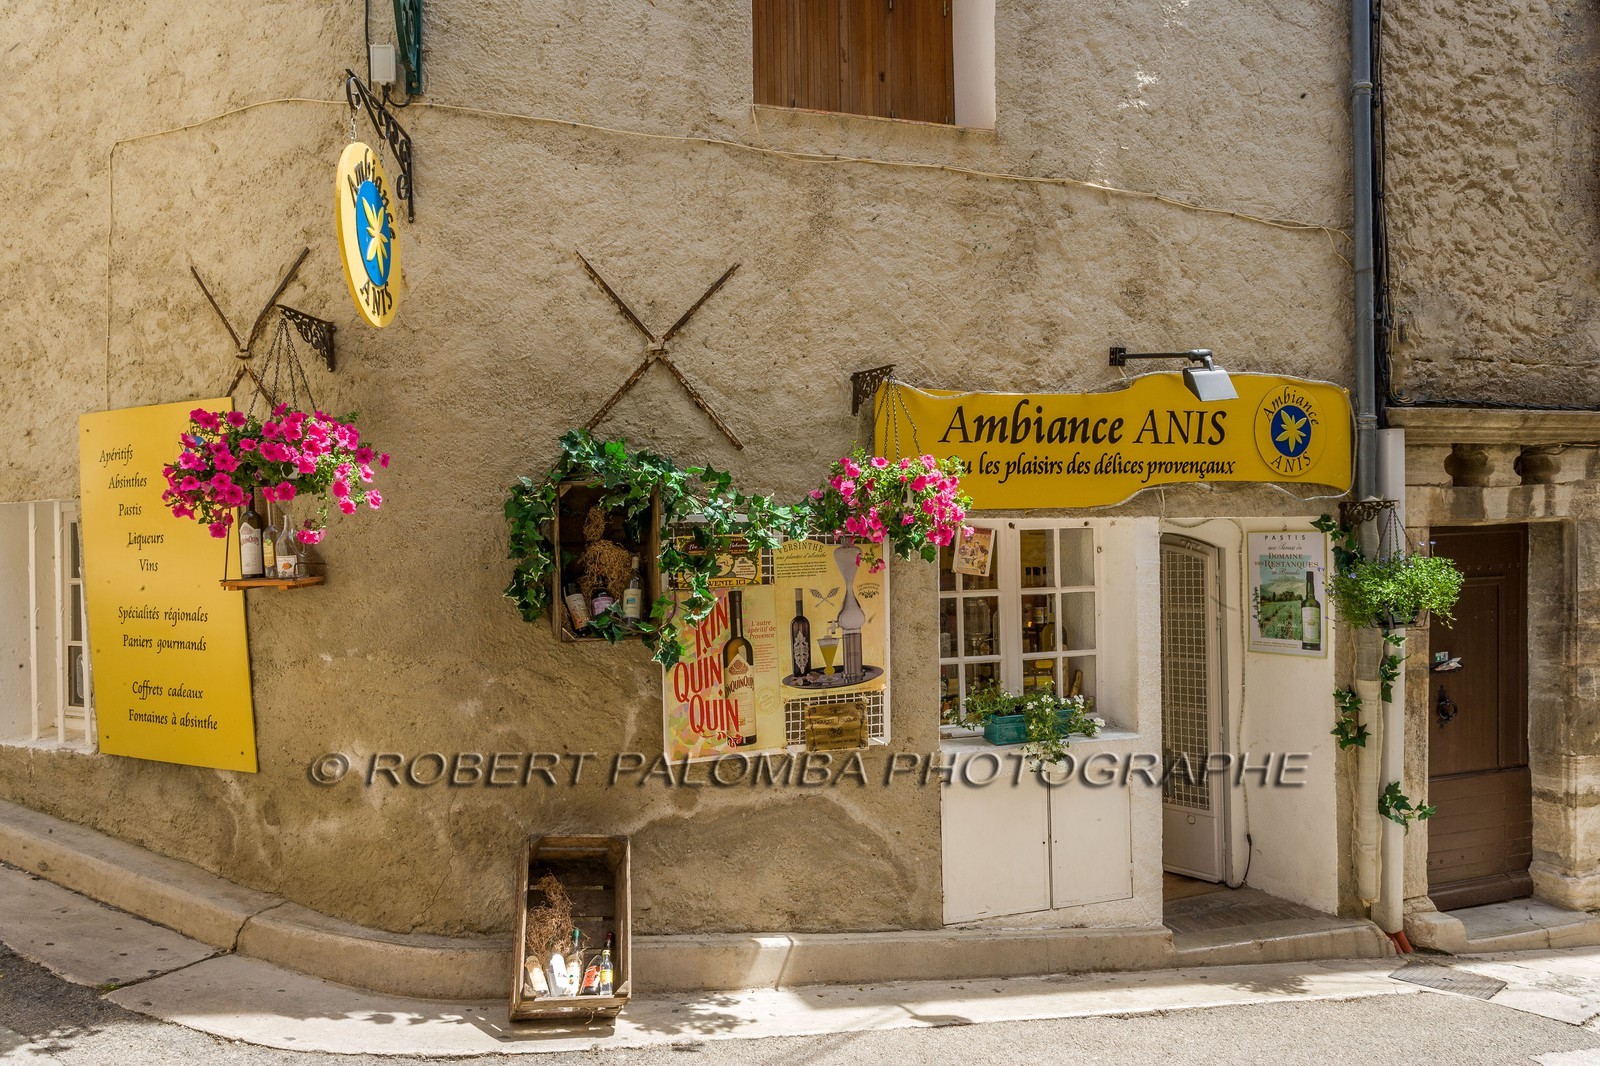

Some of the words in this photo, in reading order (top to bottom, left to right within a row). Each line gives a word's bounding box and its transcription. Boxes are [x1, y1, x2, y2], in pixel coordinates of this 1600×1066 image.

[347, 147, 396, 240] Ambiance
[360, 279, 392, 317] ANIS
[1263, 386, 1319, 426] Ambiance
[938, 399, 1124, 444] Ambiance
[1132, 408, 1227, 445] ANIS
[99, 444, 133, 468] Apéritifs
[979, 451, 1000, 475] les
[998, 451, 1063, 483] plaisirs
[1066, 451, 1091, 475] des
[1093, 451, 1144, 475] délices
[1141, 459, 1236, 483] provençaux
[1271, 451, 1311, 473] ANIS
[108, 472, 147, 489] Absinthes
[118, 503, 142, 516] Pastis
[128, 532, 164, 551] Liqueurs
[139, 558, 158, 572] Vins
[1264, 559, 1319, 569] RESTANQUES
[1268, 552, 1304, 560] DOMAINE
[118, 604, 160, 625] Spécialités
[164, 606, 208, 627] régionales
[747, 625, 768, 634] apéritif
[749, 632, 775, 640] Provence
[122, 634, 153, 648] Paniers
[157, 635, 207, 654] gourmands
[673, 650, 723, 703] QUIN
[132, 680, 163, 700] Coffrets
[167, 682, 203, 699] cadeaux
[128, 708, 168, 725] Fontaines
[171, 712, 177, 725] à
[180, 711, 218, 730] absinthe
[689, 691, 740, 734] QUIN
